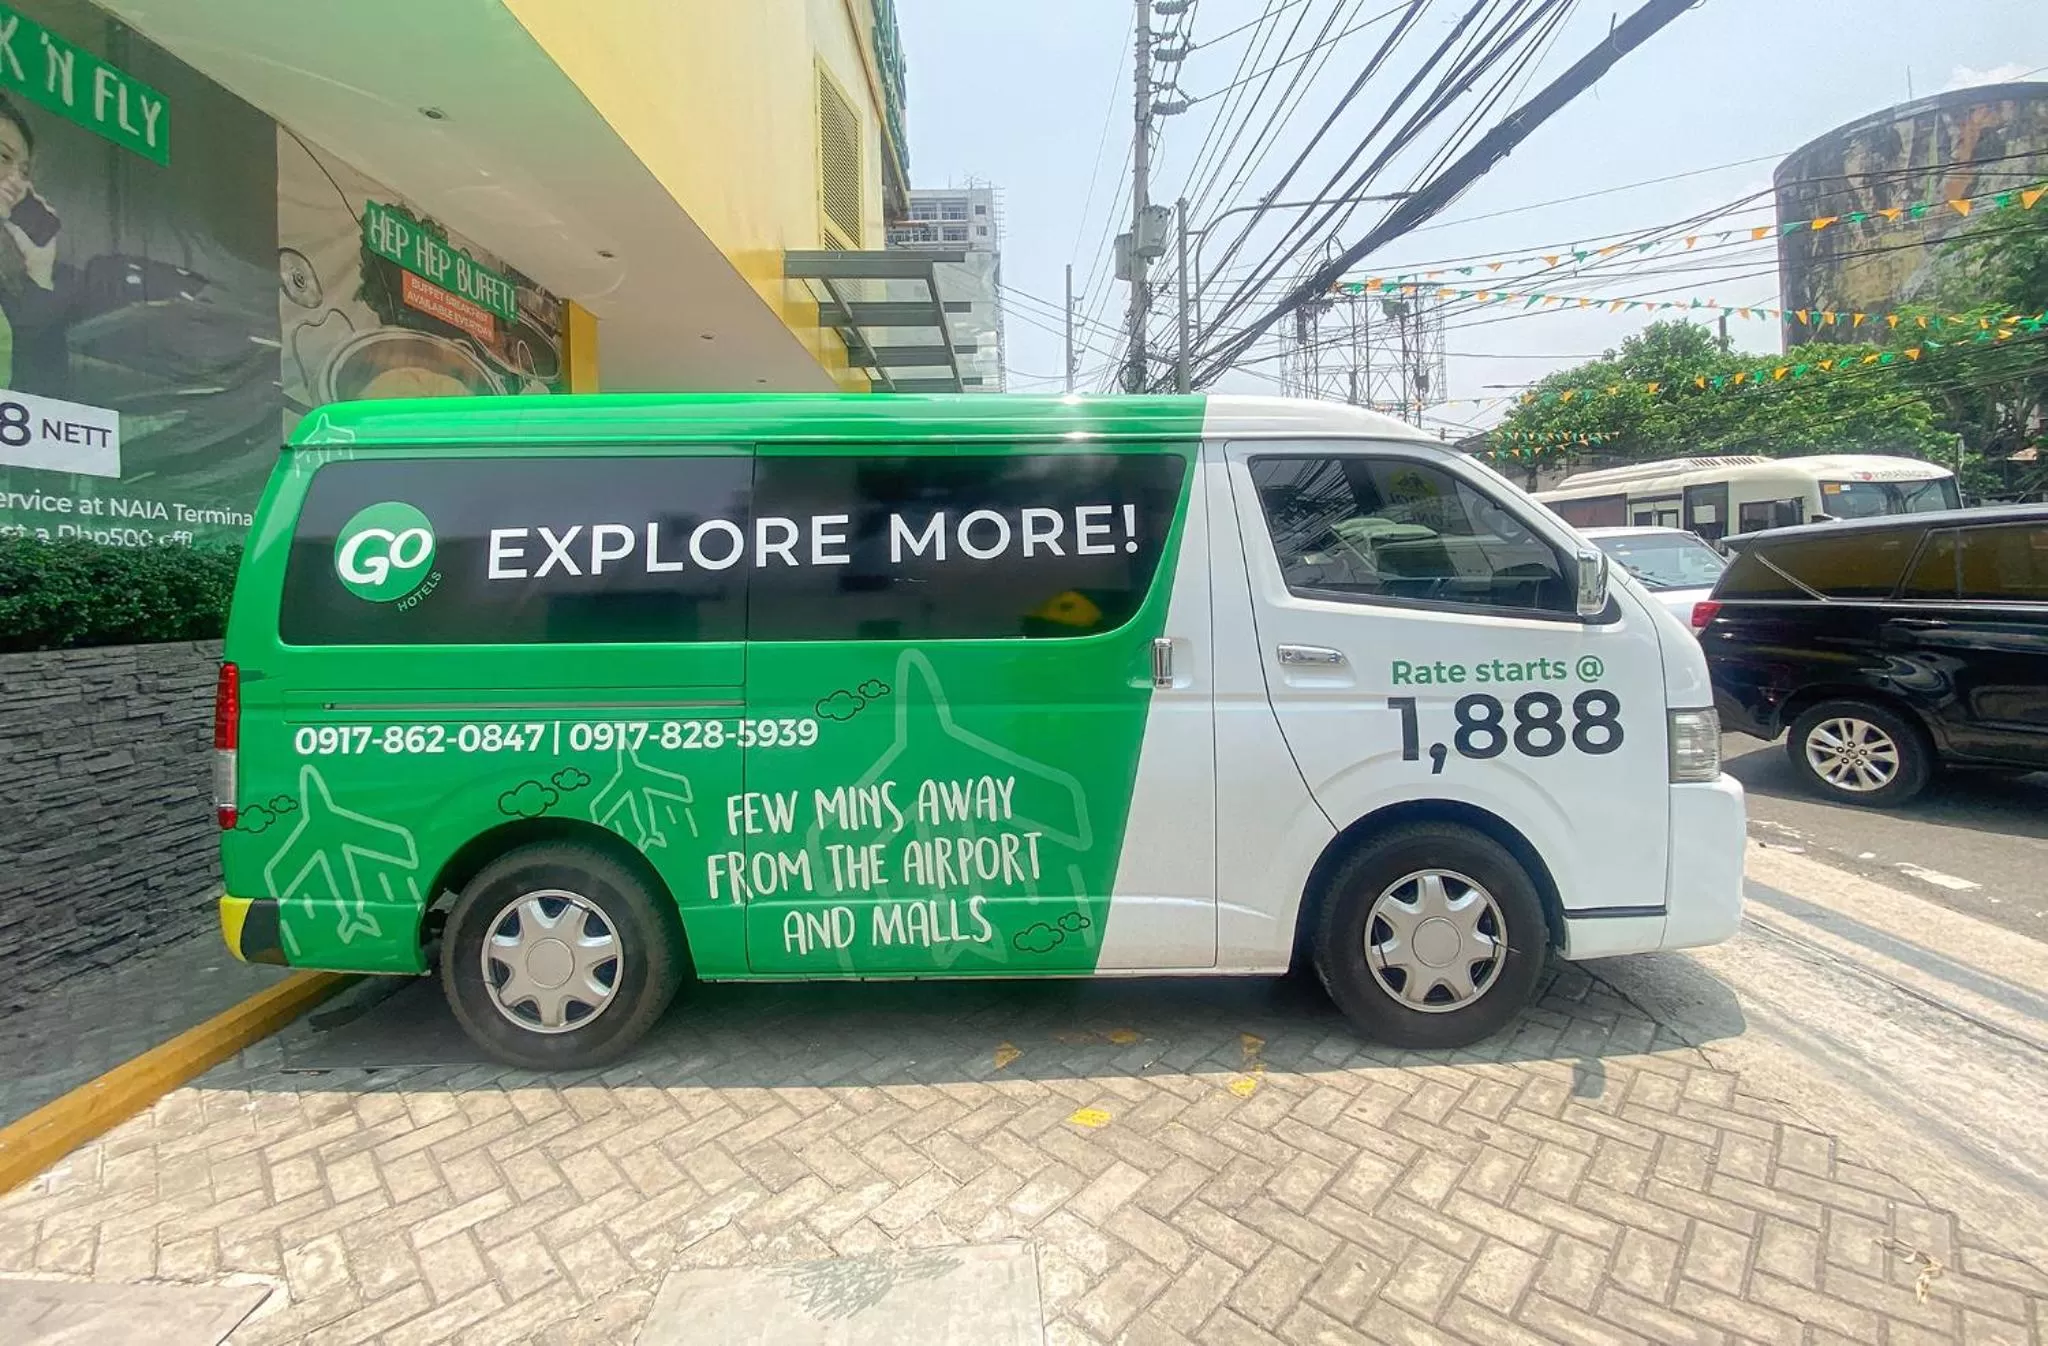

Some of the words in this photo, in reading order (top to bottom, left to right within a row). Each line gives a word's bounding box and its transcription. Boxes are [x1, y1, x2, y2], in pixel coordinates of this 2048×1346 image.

[40, 31, 74, 107] 'N
[94, 65, 162, 147] FLY
[370, 209, 409, 259] HEP
[416, 233, 451, 282] HEP
[456, 257, 516, 320] BUFFET!
[42, 418, 112, 448] NETT
[78, 497, 104, 516] at
[110, 498, 169, 521] NAIA
[173, 503, 257, 527] Termina
[487, 514, 850, 580] EXPLORE
[889, 504, 1139, 563] MORE!
[338, 528, 434, 585] GO
[397, 571, 442, 612] HOTELS
[1391, 660, 1467, 685] Rate
[1475, 657, 1568, 682] starts
[1575, 654, 1605, 683] @
[294, 723, 544, 755] 0917-862-0847
[569, 718, 819, 752] 0917-828-5939
[1387, 689, 1625, 775] 1,888
[727, 790, 798, 836] FEW
[814, 780, 905, 833] MINS
[917, 775, 1016, 826] AWAY
[707, 848, 814, 905] FROM
[825, 843, 889, 892] THE
[903, 831, 1043, 890] AIRPORT
[783, 905, 855, 956] AND
[871, 894, 993, 947] MALLS
